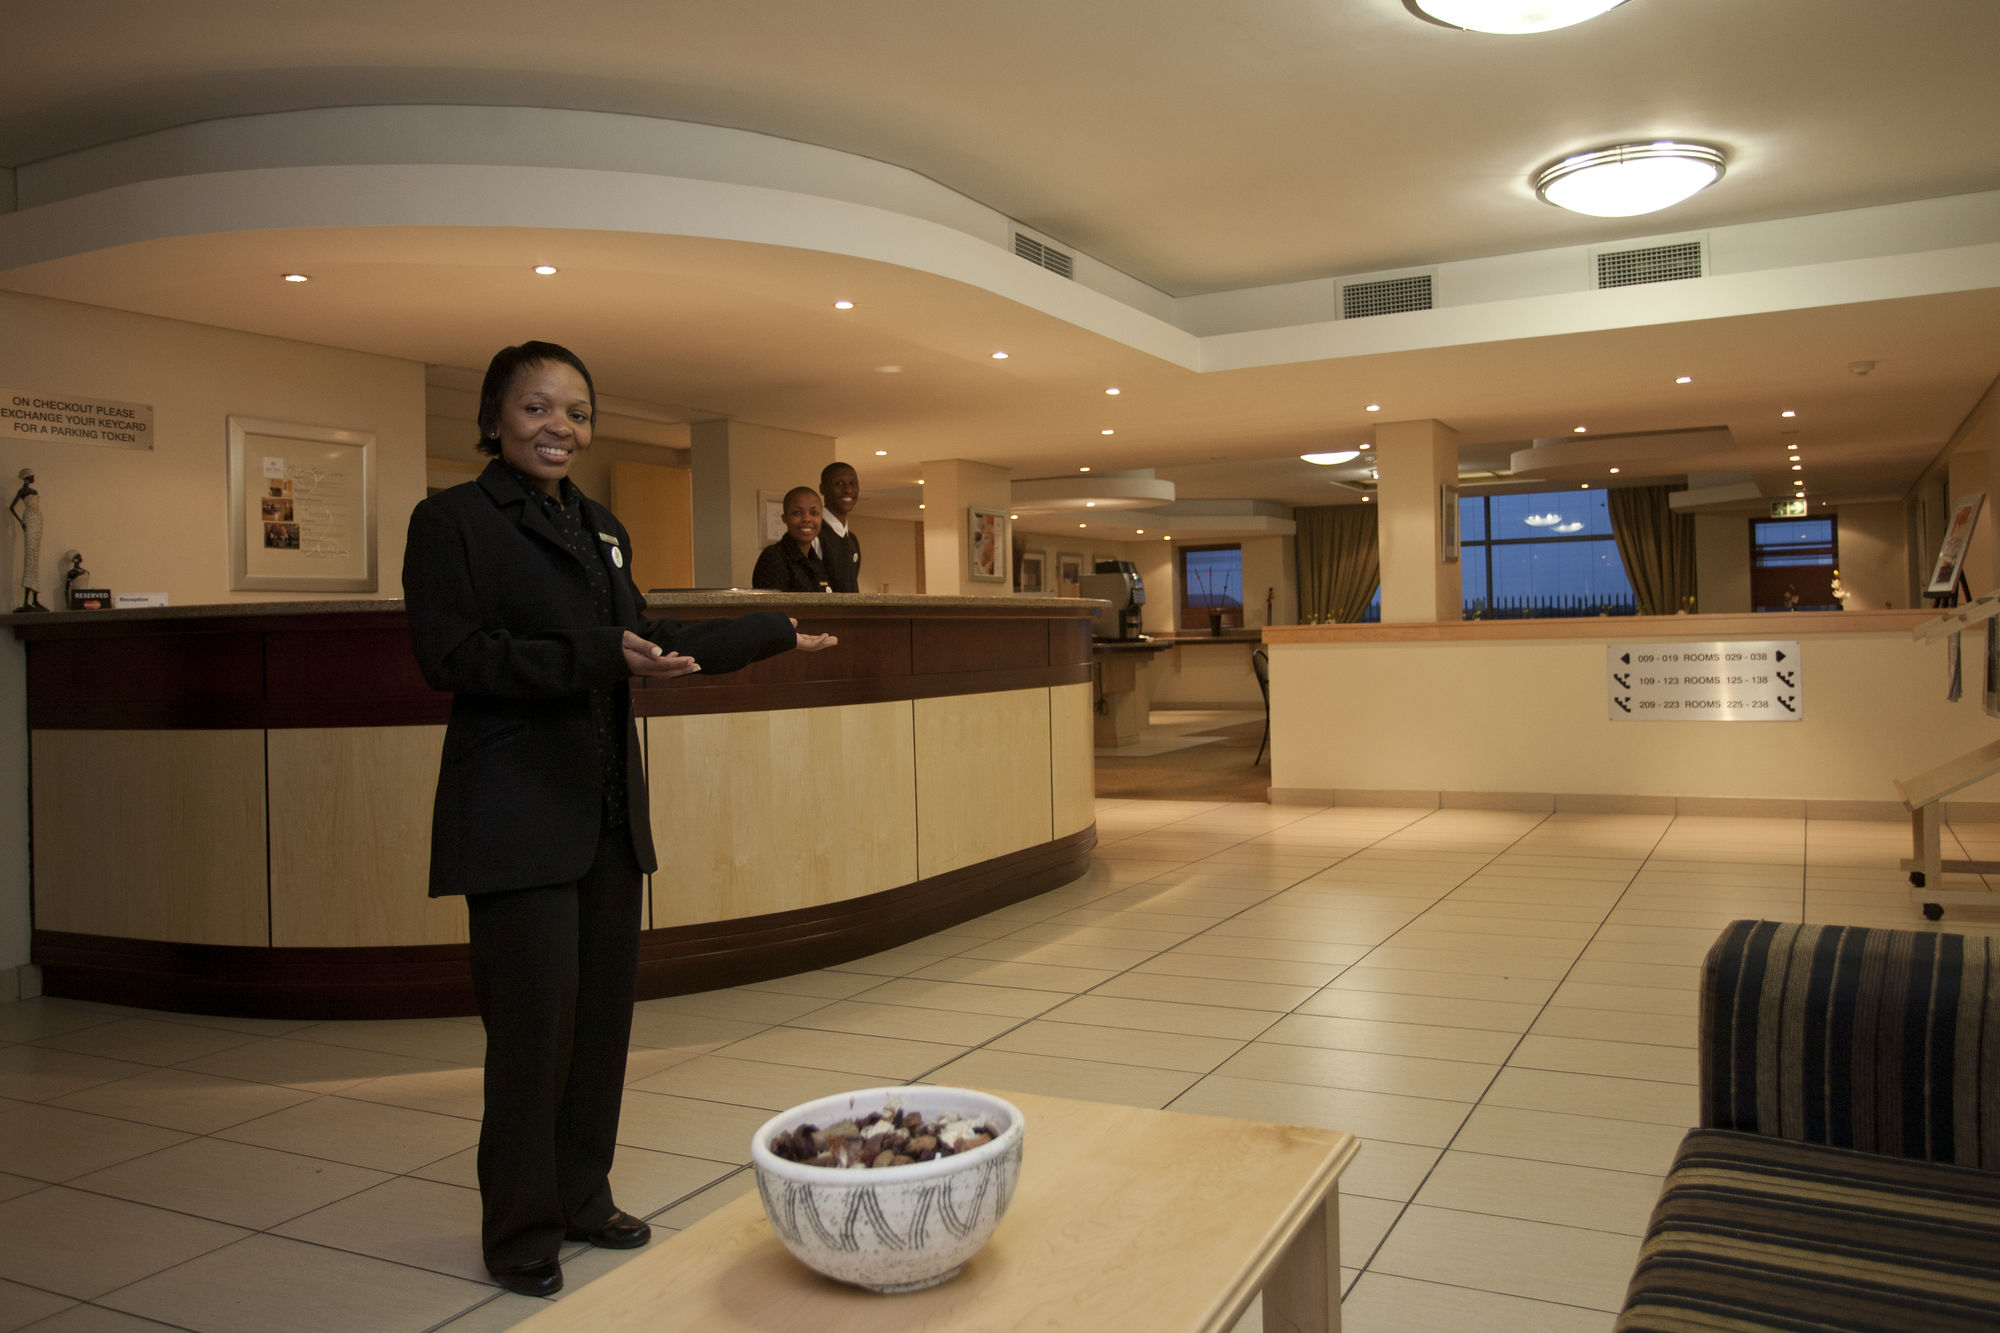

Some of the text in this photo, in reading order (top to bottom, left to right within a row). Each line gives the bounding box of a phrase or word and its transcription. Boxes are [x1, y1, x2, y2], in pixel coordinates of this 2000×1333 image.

[12, 396, 136, 419] ON CHECKOUT PLEASE
[0, 407, 146, 432] EXCHANGE YOUR KEYCARD
[14, 422, 136, 443] FOR A PARKING TOKEN
[1637, 655, 1655, 663] 009
[1662, 655, 1679, 663] 019
[1683, 654, 1720, 662] ROOMS
[1725, 653, 1742, 662] 029
[1750, 653, 1768, 662] 038
[1639, 676, 1655, 685] 109
[1663, 676, 1679, 685] 123
[1684, 676, 1721, 685] ROOMS
[1726, 676, 1743, 685] 125
[1752, 676, 1769, 685] 138
[1639, 700, 1656, 709] 209
[1663, 700, 1680, 709] 223
[1684, 700, 1721, 709] ROOMS
[1726, 700, 1743, 709] 225
[1751, 700, 1769, 709] 238
